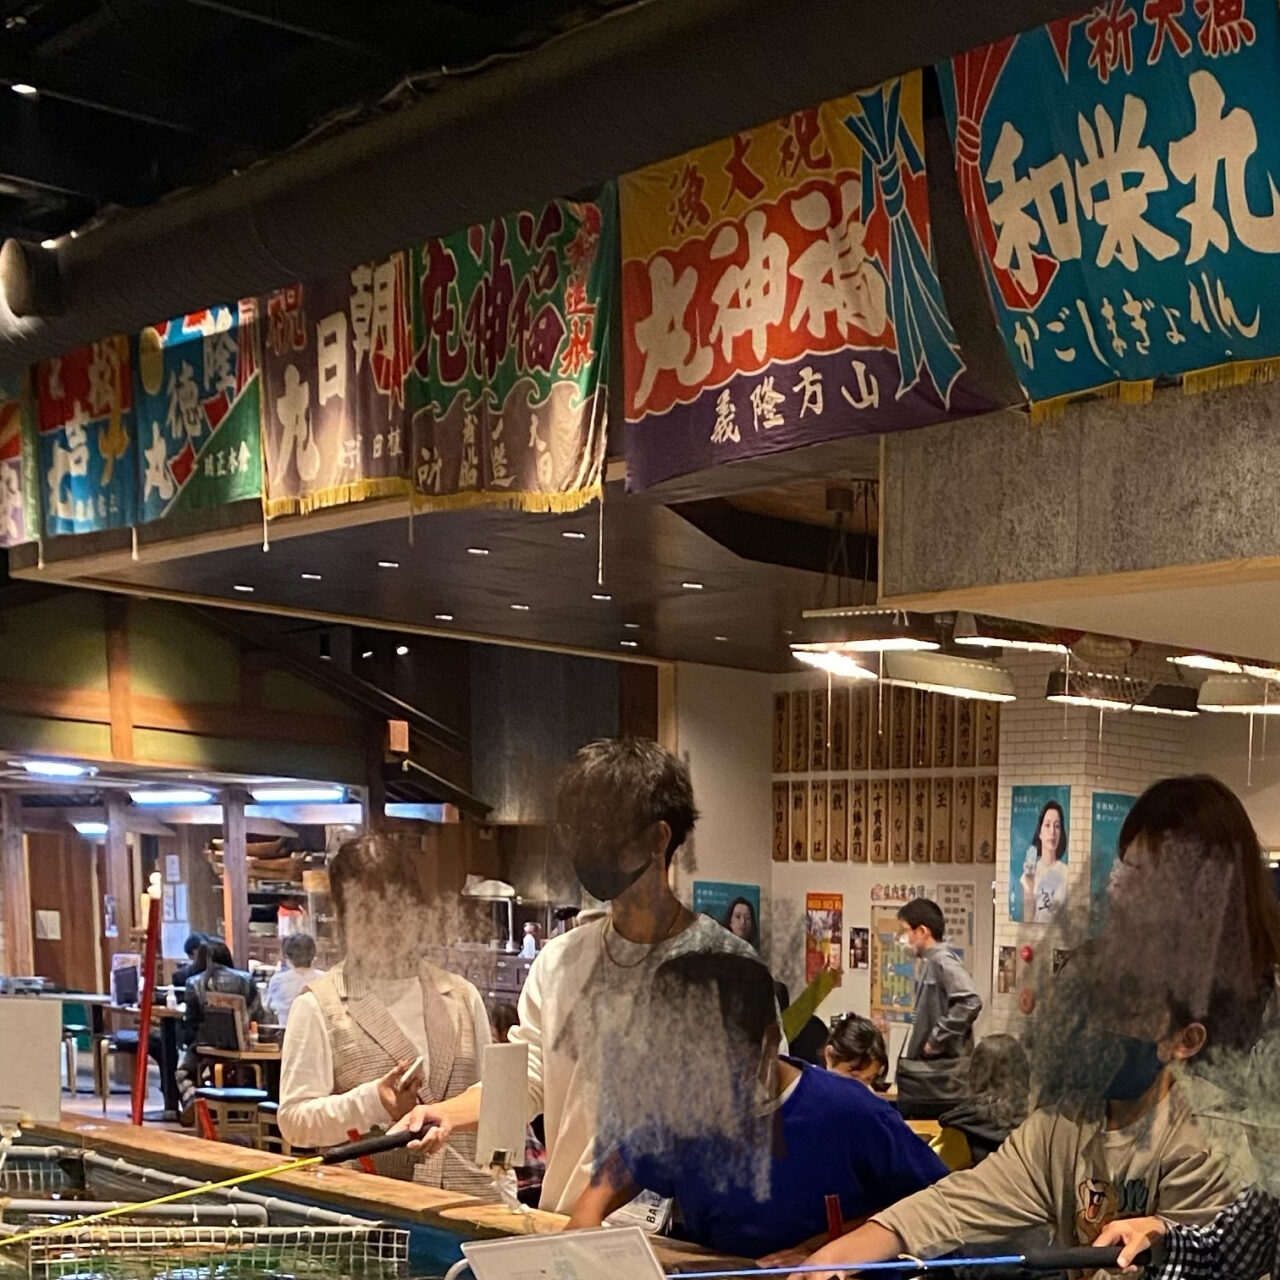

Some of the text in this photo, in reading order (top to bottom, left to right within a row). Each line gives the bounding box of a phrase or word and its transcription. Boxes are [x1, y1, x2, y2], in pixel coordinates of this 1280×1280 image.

[1014, 272, 1260, 370] かごしまぎょれん
[273, 258, 396, 486] 朝日丸
[710, 360, 880, 443] 山方隆義
